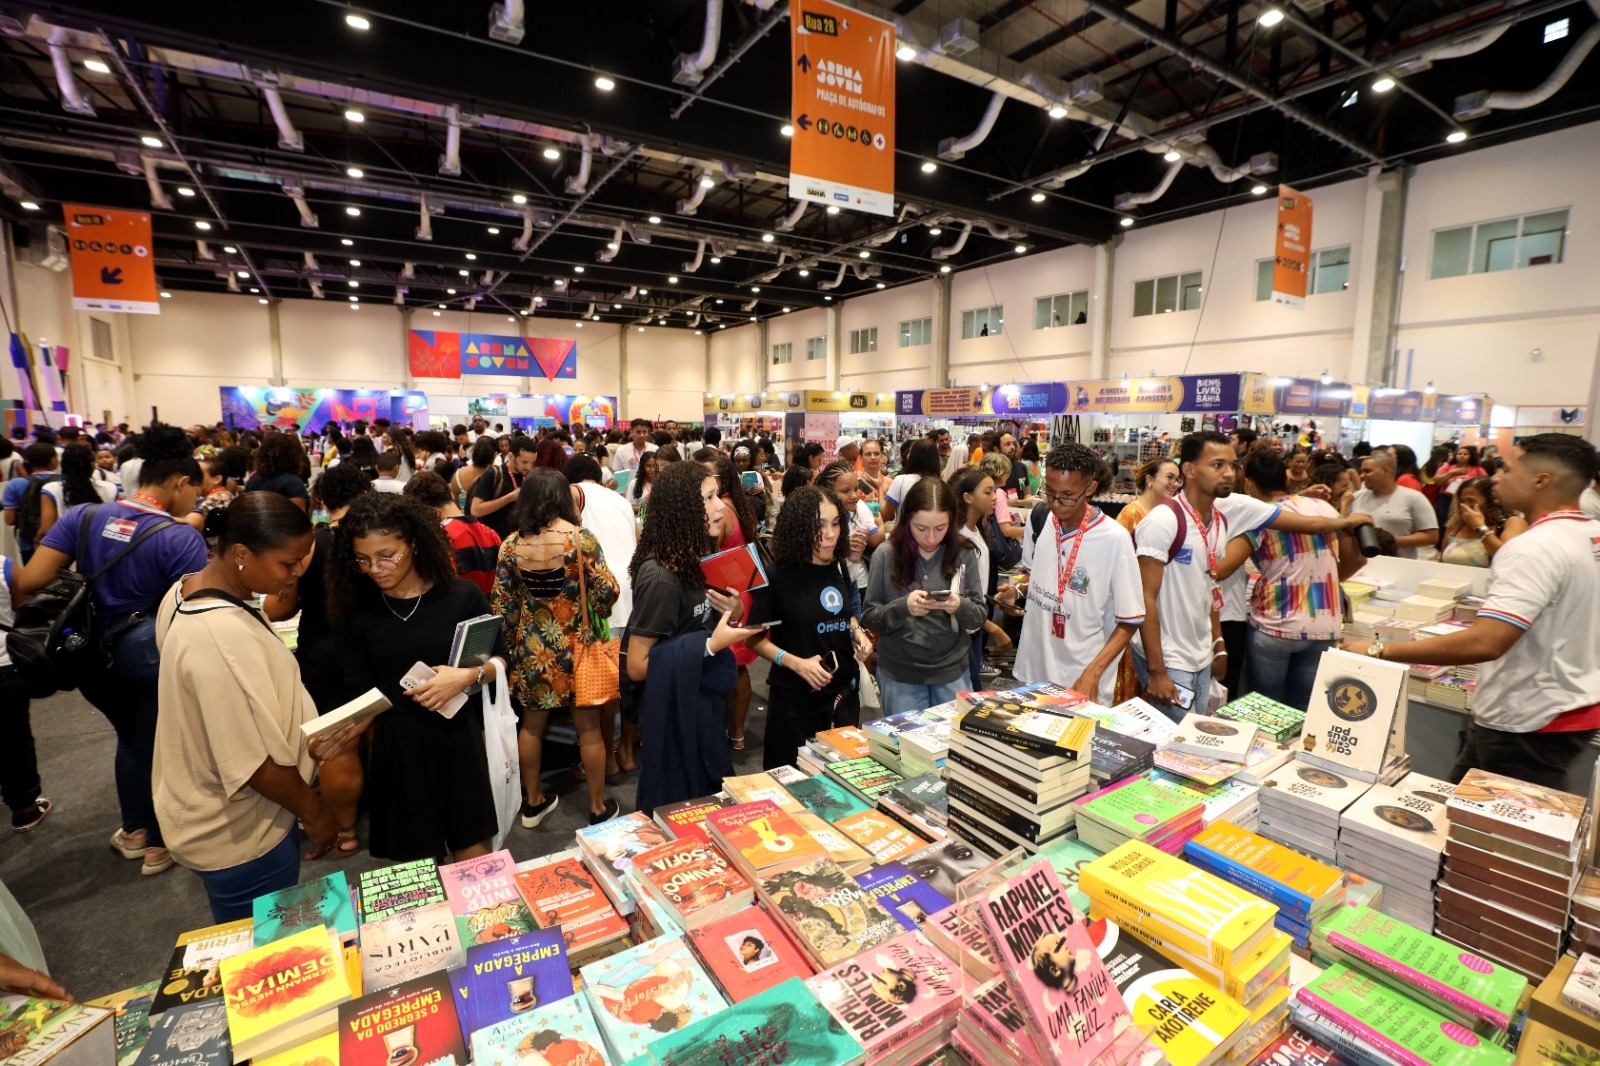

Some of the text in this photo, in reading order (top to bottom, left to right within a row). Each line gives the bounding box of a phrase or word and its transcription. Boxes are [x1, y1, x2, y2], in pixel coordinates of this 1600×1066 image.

[806, 14, 822, 32] Rua
[816, 88, 886, 117] PRAÇA DE AUTÓGRAFOS
[1327, 730, 1358, 746] Deus
[1332, 725, 1351, 736] pai
[1326, 743, 1352, 756] café
[668, 804, 722, 821] EMPREGADA
[652, 849, 707, 870] SOFIA
[662, 865, 724, 893] MUNDO
[474, 894, 514, 914] INTER
[833, 890, 864, 907] MATA
[890, 893, 901, 901] A
[988, 870, 1060, 932] RAPHAEL
[1005, 897, 1074, 964] MONTES
[374, 946, 452, 973] BIBLIOTECA
[474, 944, 560, 975] EMPREGADA
[514, 965, 523, 976] A
[919, 952, 953, 978] FELIZ
[225, 955, 333, 1001] DEMIAN
[276, 966, 336, 993] HERMANN
[923, 976, 955, 997] UMA
[180, 984, 222, 1002] ADA
[837, 964, 908, 1029] MONTES
[1048, 999, 1074, 1039] UMA
[1073, 969, 1110, 1014] FAMÍLIA
[1148, 991, 1189, 1021] CARLA
[350, 990, 442, 1032] EMPREGADA
[357, 1004, 438, 1041] O SEGREDO DA
[1155, 992, 1216, 1044] AKOTIRENE
[1074, 1008, 1106, 1050] FELIZ
